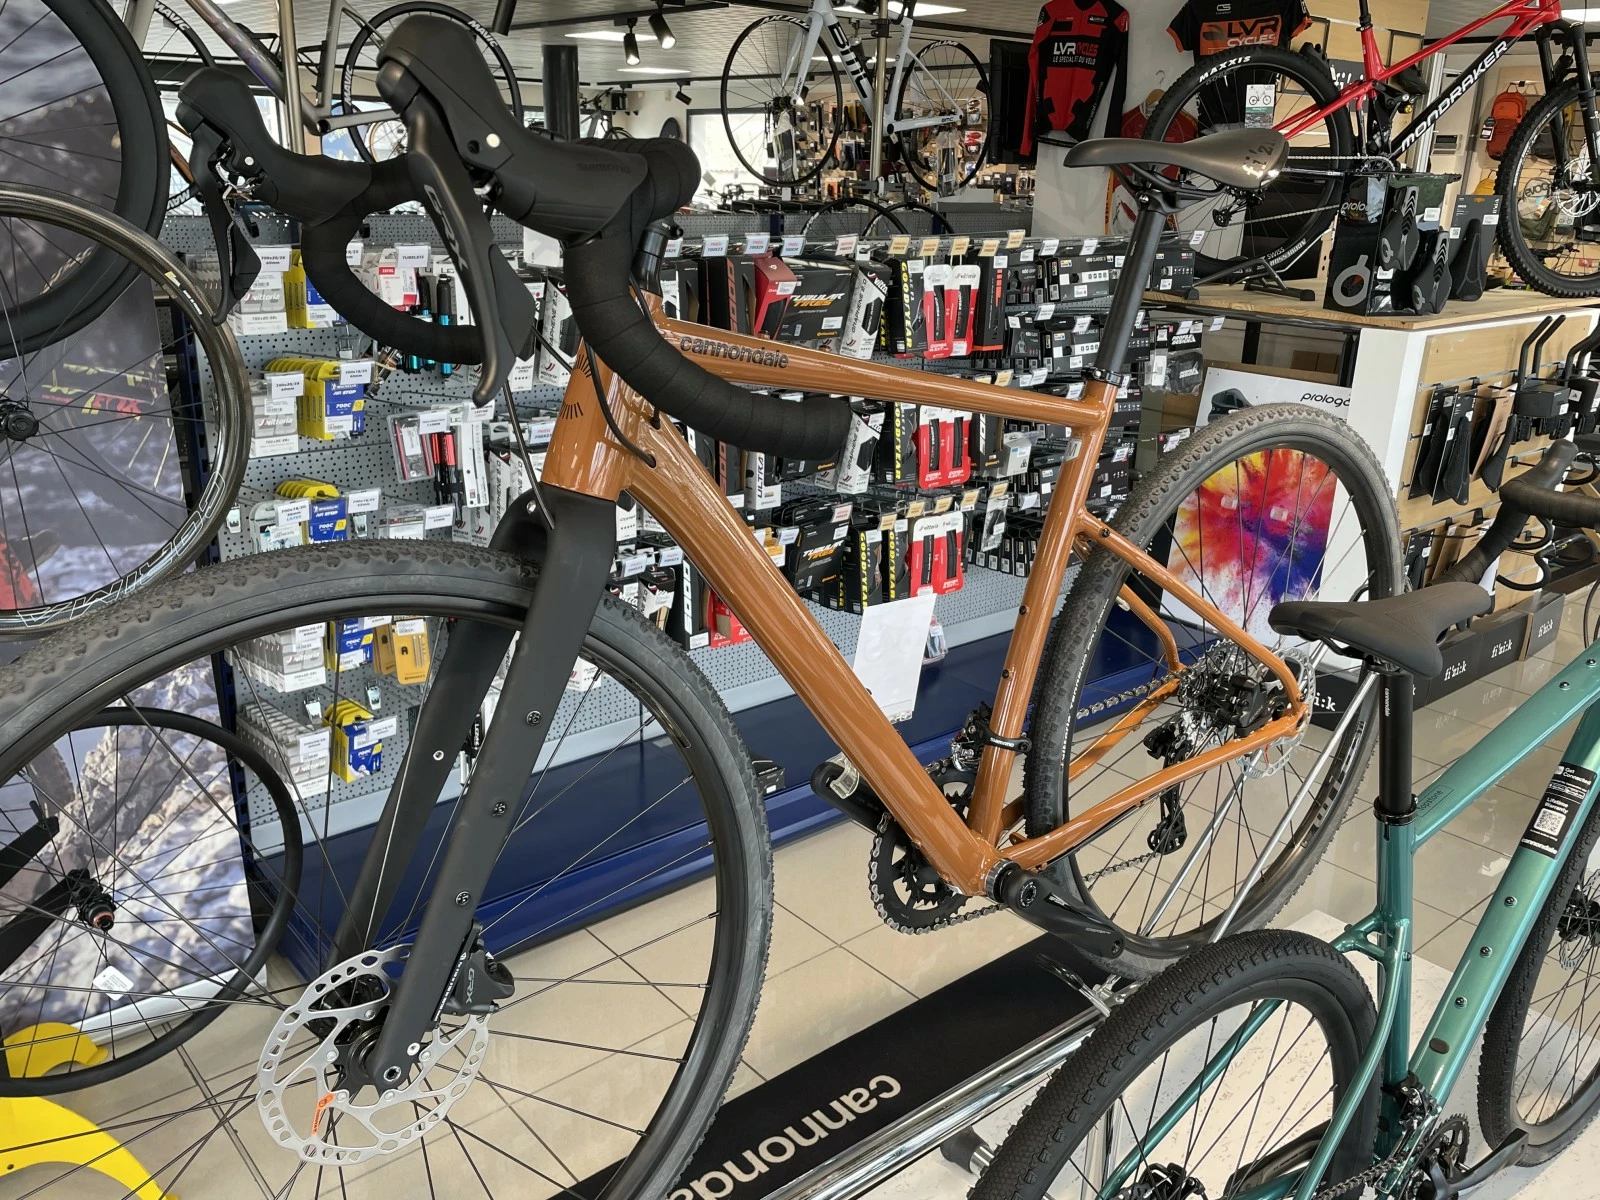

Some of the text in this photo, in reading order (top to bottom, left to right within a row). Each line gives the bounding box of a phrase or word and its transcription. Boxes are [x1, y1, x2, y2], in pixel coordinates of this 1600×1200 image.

[467, 19, 499, 48] MAVIC
[1227, 16, 1278, 38] LVR
[1053, 42, 1076, 55] LVR
[1226, 33, 1276, 47] CYCLES
[1199, 55, 1252, 83] MAXXIS
[344, 66, 353, 106] MAVIC
[1400, 40, 1508, 152] MONDRAKER
[166, 191, 190, 210] MAV
[1341, 201, 1366, 212] prolo
[1267, 247, 1285, 260] SWISS
[789, 292, 846, 302] TUBULAR
[793, 299, 833, 307] TIRES
[902, 261, 912, 349] GOODYEAR
[679, 335, 789, 370] cannondale
[267, 418, 293, 426] vittoria
[1066, 441, 1079, 461] M
[757, 455, 766, 498] ULTRA
[803, 540, 845, 557] TUBULAR
[860, 531, 868, 608] GOODYEAR
[295, 652, 320, 662] vittoria
[1491, 638, 1513, 659] fi'zi:k
[1444, 660, 1467, 682] fi'zi:k
[1563, 772, 1592, 786] Connected
[1417, 790, 1444, 811] topstone
[1546, 797, 1569, 808] Lifetime
[1521, 838, 1558, 855] cannondale
[466, 967, 475, 1004] GRX
[664, 1074, 902, 1200] cannond
